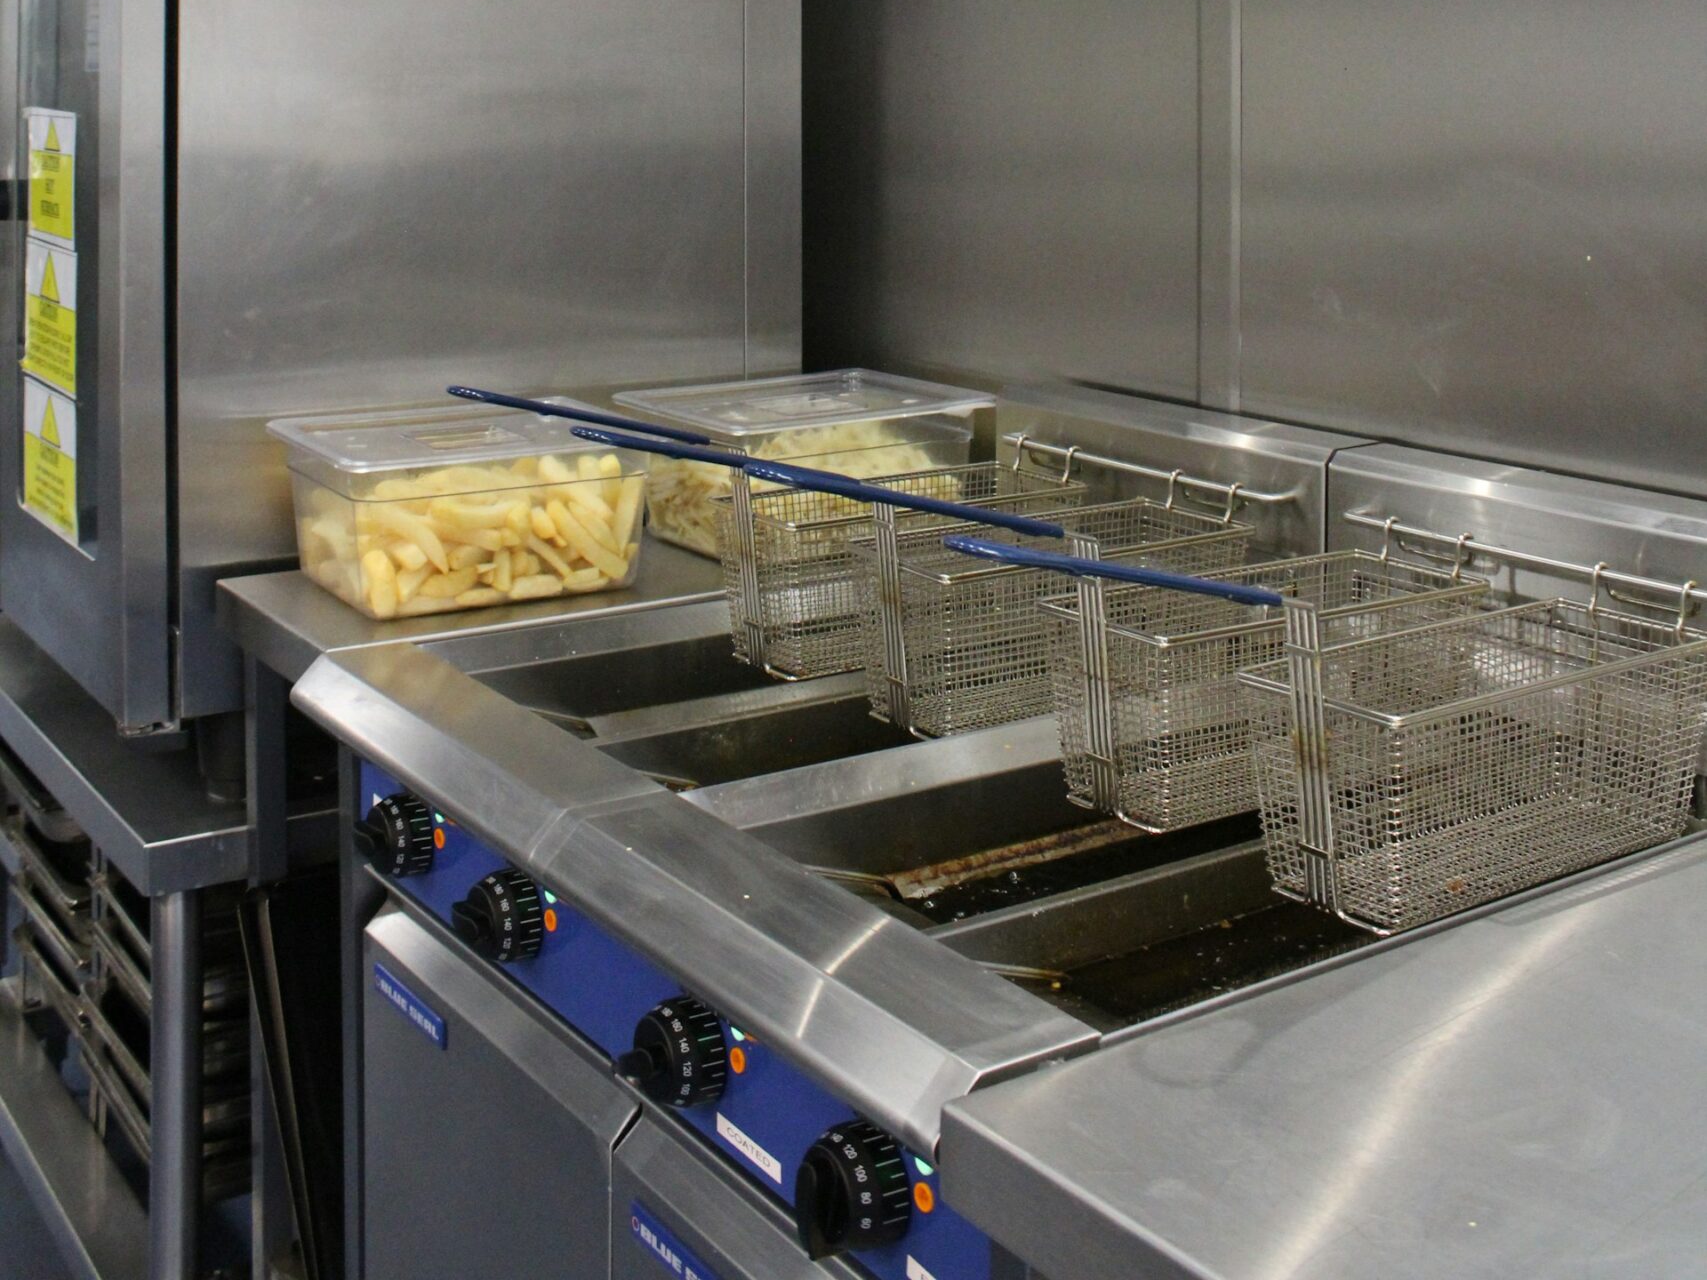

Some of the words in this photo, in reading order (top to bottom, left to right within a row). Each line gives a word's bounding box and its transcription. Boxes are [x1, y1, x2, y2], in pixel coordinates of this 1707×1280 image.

[398, 835, 406, 848] 140
[500, 898, 510, 912] 160
[504, 917, 512, 931] 140
[380, 978, 408, 1012] BLUE
[408, 1005, 440, 1040] SEAL
[671, 1018, 683, 1032] 160
[679, 1037, 690, 1053] 140
[683, 1061, 692, 1077] 120
[680, 1083, 691, 1096] 100
[726, 1127, 771, 1168] COATED
[843, 1143, 858, 1160] 120
[854, 1164, 868, 1183] 100
[860, 1191, 872, 1205] 80
[860, 1217, 872, 1230] 60
[640, 1223, 683, 1274] BLUE
